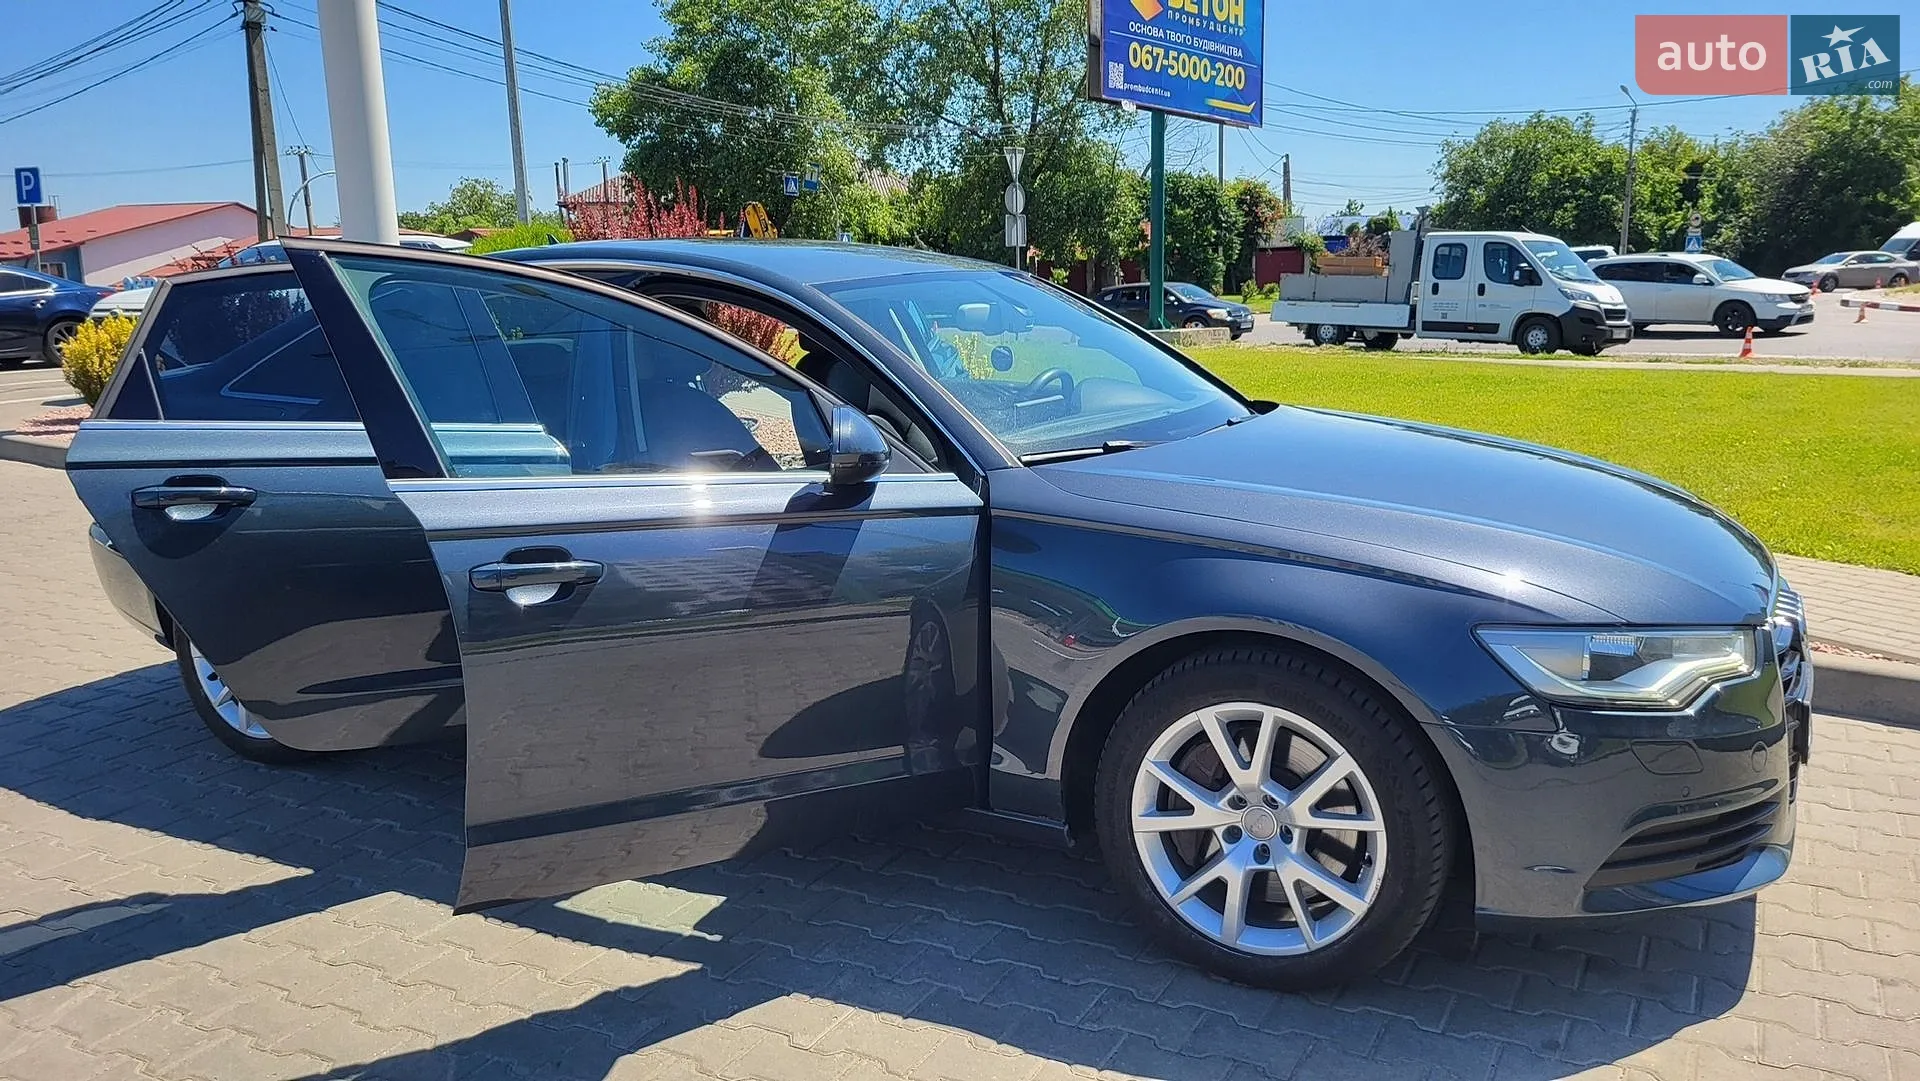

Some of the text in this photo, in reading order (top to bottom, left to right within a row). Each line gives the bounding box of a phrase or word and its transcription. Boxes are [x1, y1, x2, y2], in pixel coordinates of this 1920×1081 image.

[1129, 21, 1244, 58] ОСНОВА ТВОГО БУДІВНИЦТВА
[1128, 41, 1246, 91] 067-5000-200
[20, 171, 35, 201] P
